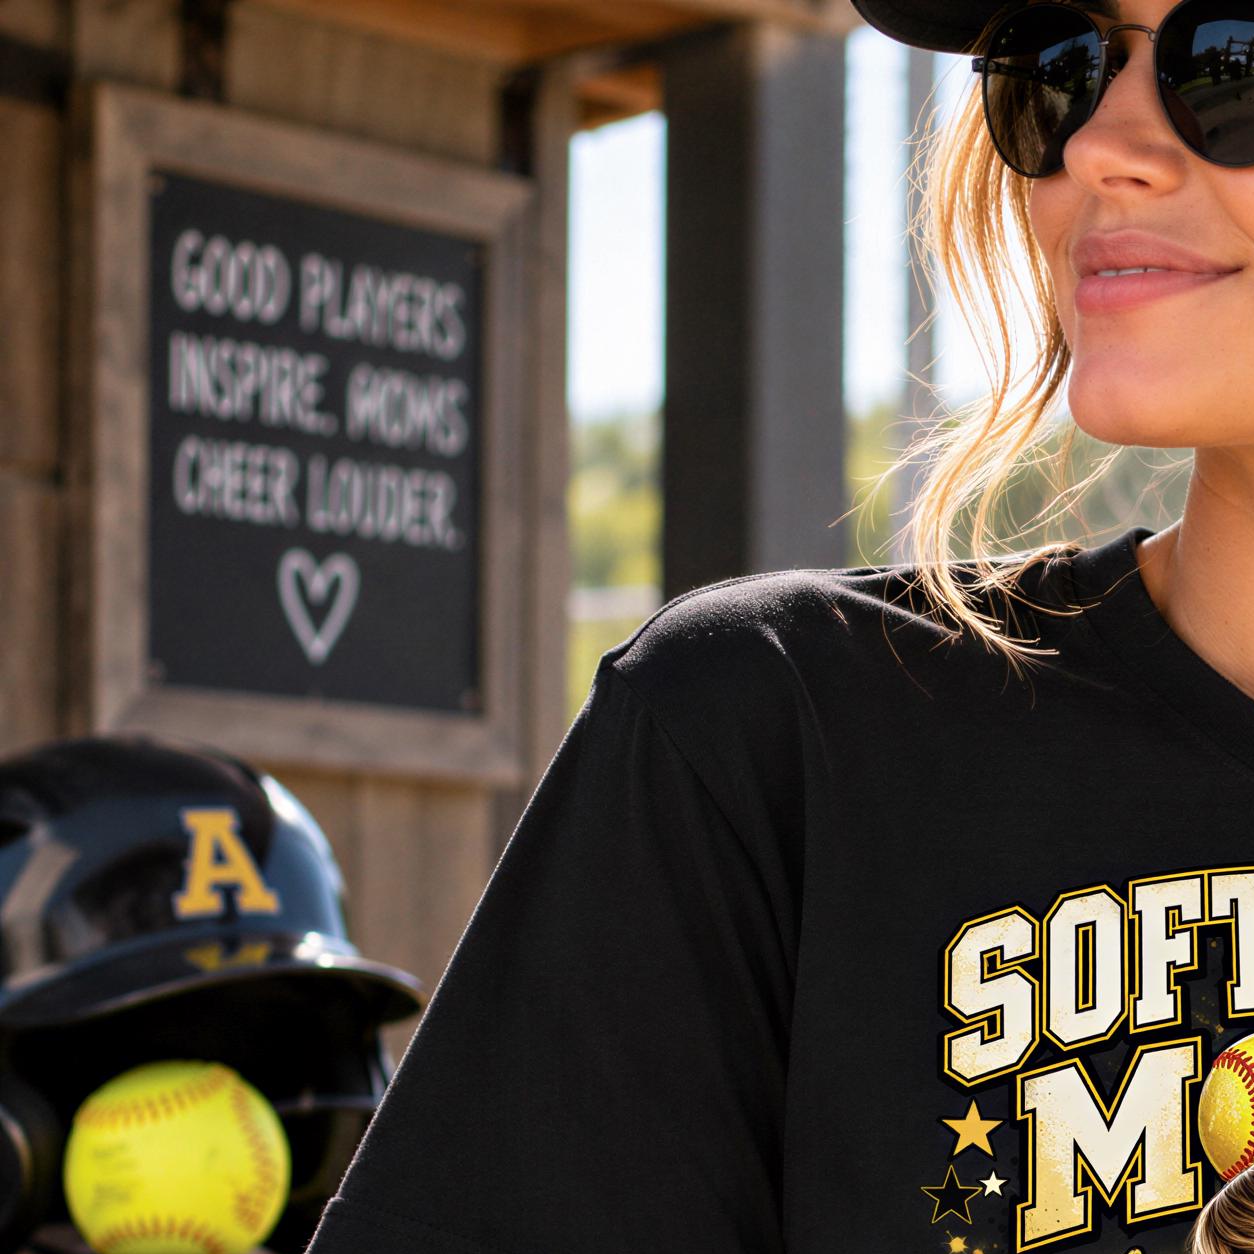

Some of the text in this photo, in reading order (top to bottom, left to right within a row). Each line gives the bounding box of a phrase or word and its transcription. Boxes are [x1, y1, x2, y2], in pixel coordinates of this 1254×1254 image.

[171, 229, 467, 361] GOOD PLAYERS
[168, 329, 469, 457] INSPIRE. MOMS
[172, 434, 465, 552] CHEER LOUDER.
[172, 808, 280, 919] A
